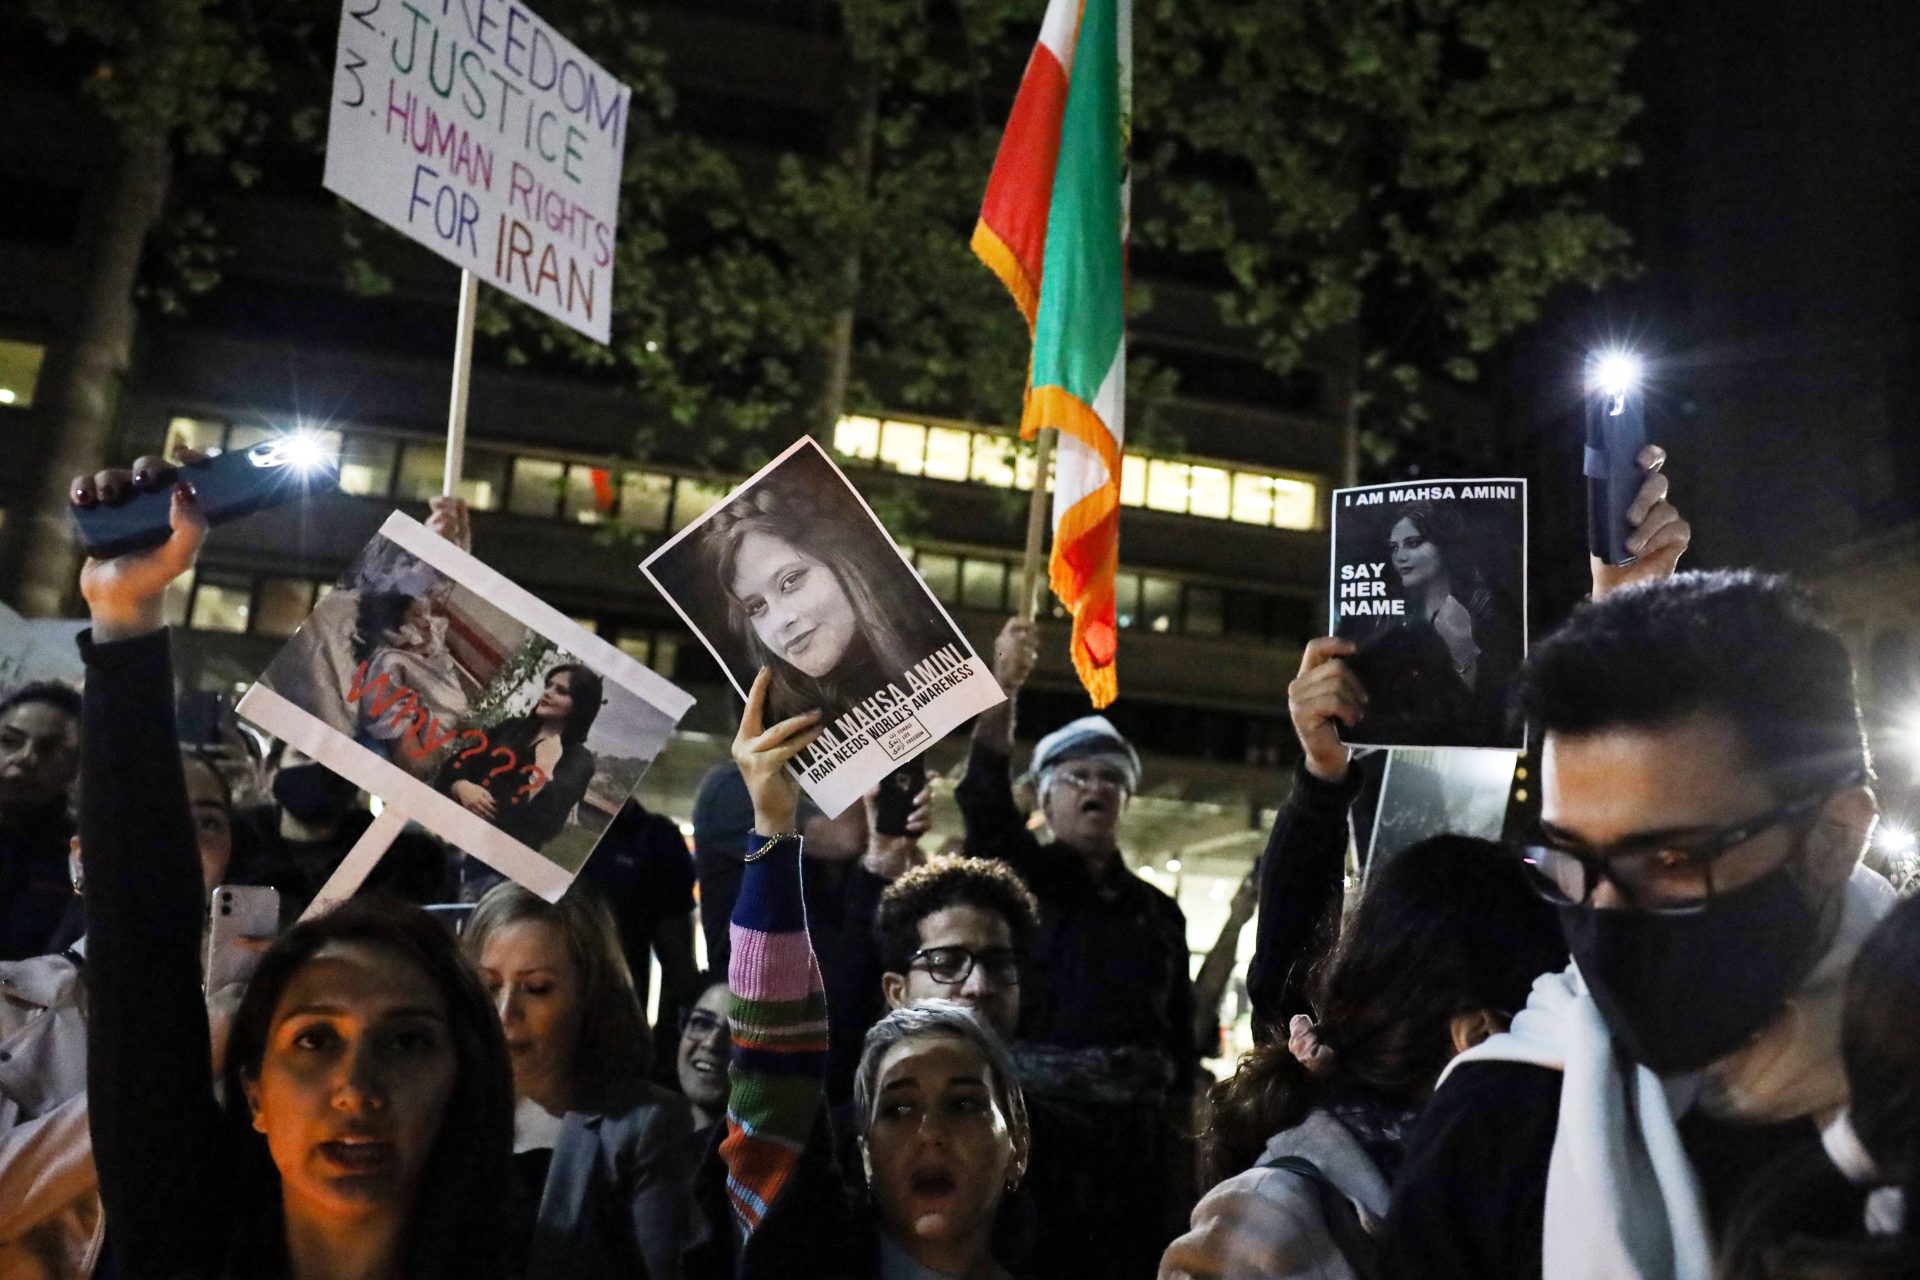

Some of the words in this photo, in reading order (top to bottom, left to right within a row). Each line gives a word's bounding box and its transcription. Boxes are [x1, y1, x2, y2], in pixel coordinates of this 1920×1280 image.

[391, 1, 590, 185] JUSTICE
[342, 47, 377, 117] 3.
[386, 78, 494, 192] HUMAN
[509, 161, 611, 268] RIGHTS
[408, 164, 480, 258] FOR
[495, 213, 595, 322] IRAN
[1345, 495, 1351, 507] I
[1356, 491, 1384, 506] AM
[1389, 487, 1456, 502] MAHSA
[1460, 486, 1516, 499] AMINI
[1341, 562, 1386, 580] SAY
[1340, 581, 1387, 598] HER
[1340, 600, 1405, 616] NAME
[794, 752, 810, 771] I
[807, 727, 840, 762] AM
[835, 682, 909, 738] MAHSA
[903, 642, 966, 694] AMINI
[808, 757, 837, 784] IRAN
[833, 734, 869, 764] NEEDS
[866, 704, 914, 740] WORLD'S
[911, 663, 974, 711] AWARENESS
[901, 731, 911, 740] LIFE
[906, 730, 924, 744] FREEDOM
